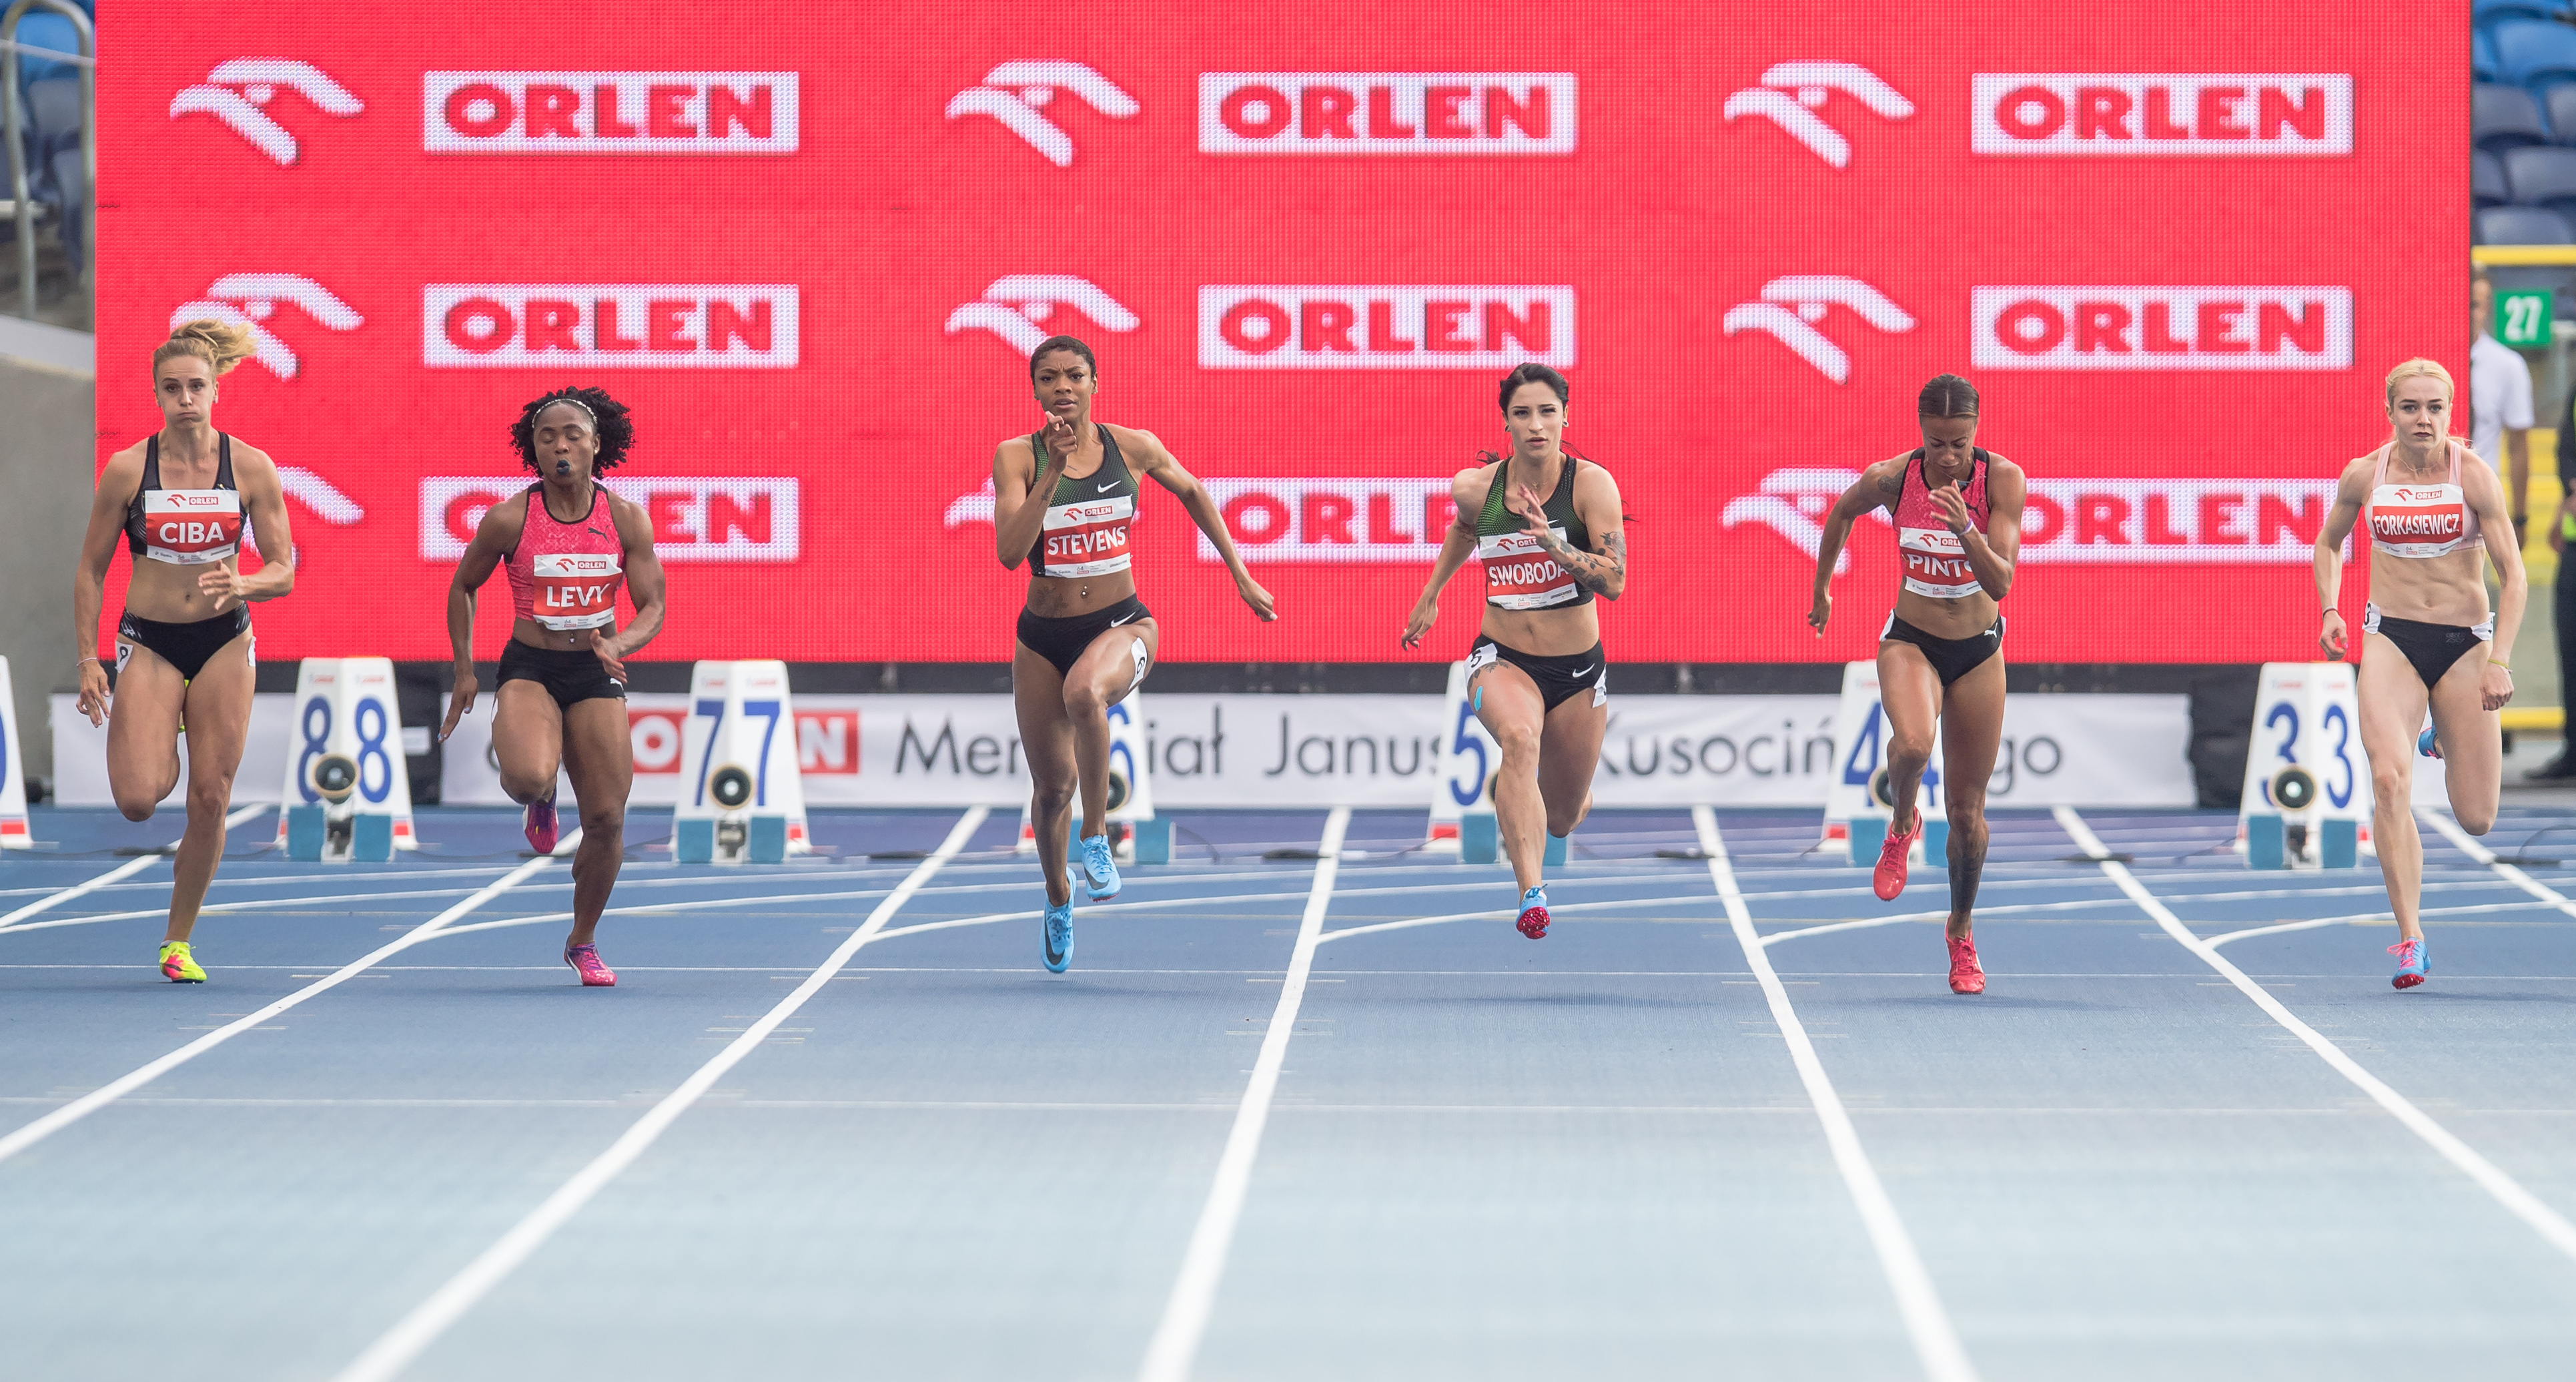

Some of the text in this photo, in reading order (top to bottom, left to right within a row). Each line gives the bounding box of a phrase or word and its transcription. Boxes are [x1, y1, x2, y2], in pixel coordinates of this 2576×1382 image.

[445, 83, 772, 138] ORLEN
[1220, 85, 1551, 139] ORLEN
[1995, 85, 2325, 140] ORLEN
[445, 296, 772, 355] ORLEN
[1220, 298, 1551, 355] ORLEN
[1995, 299, 2325, 356] ORLEN
[2505, 296, 2543, 341] 27
[444, 490, 771, 545] OEN
[1086, 506, 1112, 516] ORLEN
[1220, 492, 1460, 545] ORLE
[2020, 494, 2325, 546] ORLEN
[2417, 491, 2441, 499] ORLEN
[159, 522, 225, 544] CIBA
[1047, 526, 1126, 556] STEVENS
[1518, 538, 1537, 547] ORLE
[2374, 513, 2460, 536] FORKASIEWICZ
[546, 583, 610, 607] LEVY
[1137, 657, 1146, 675] 6
[1470, 649, 1482, 668] 5
[298, 696, 332, 803] 8
[356, 696, 392, 803] 8
[695, 700, 725, 807] 7
[743, 700, 781, 807] 7
[1450, 701, 1486, 806] 5
[2324, 704, 2353, 809] 3
